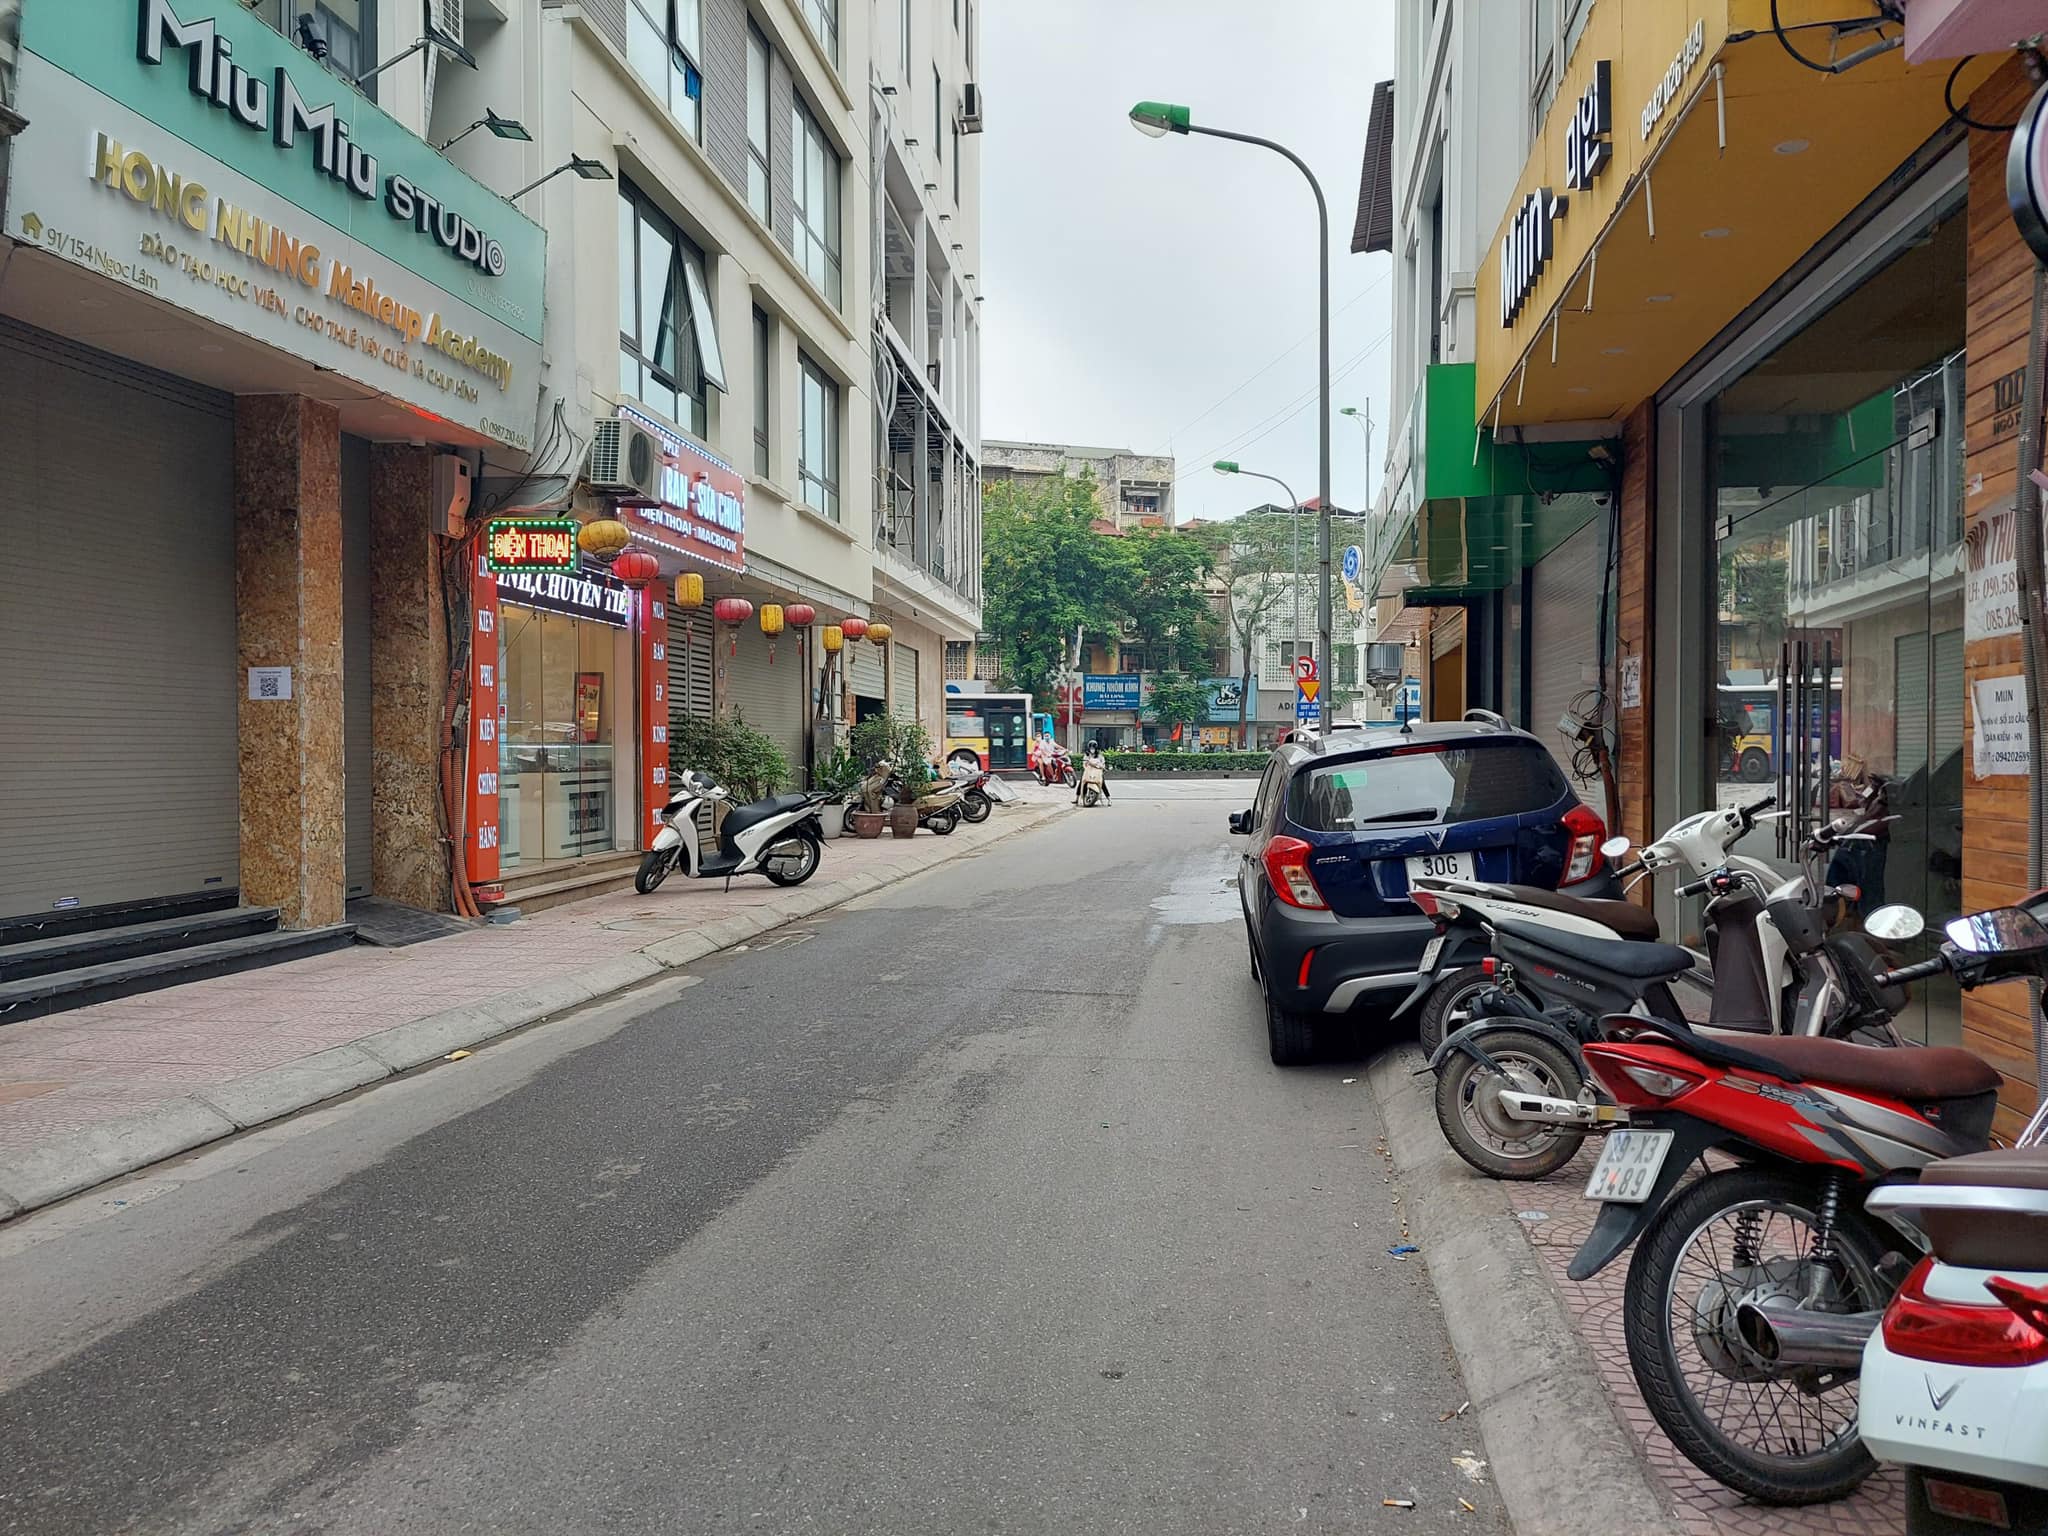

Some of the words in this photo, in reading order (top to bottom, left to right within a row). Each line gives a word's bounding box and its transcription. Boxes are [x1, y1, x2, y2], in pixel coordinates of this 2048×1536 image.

[1641, 82, 1663, 141] 0942
[137, 0, 268, 131] Miu
[273, 67, 378, 200] Miu
[384, 174, 506, 277] STUDIO
[48, 228, 93, 262] 91/154
[132, 264, 158, 290] Lâm
[139, 231, 178, 264] ĐÀO
[181, 252, 212, 281] TẠO
[214, 265, 249, 299] HỌC
[294, 305, 323, 332] CHO
[209, 197, 320, 288] NHUNG
[325, 259, 422, 343] Makeup
[422, 312, 513, 391] Academy
[494, 527, 526, 564] ĐIỆN
[530, 534, 569, 564] THOẠI
[695, 526, 737, 553] MACBOOK
[1990, 511, 2016, 566] THU
[1983, 571, 2018, 599] 090.58
[1985, 605, 2019, 631] 085.26
[1423, 855, 1458, 876] 30G
[1895, 1414, 1985, 1439] VINFAST
